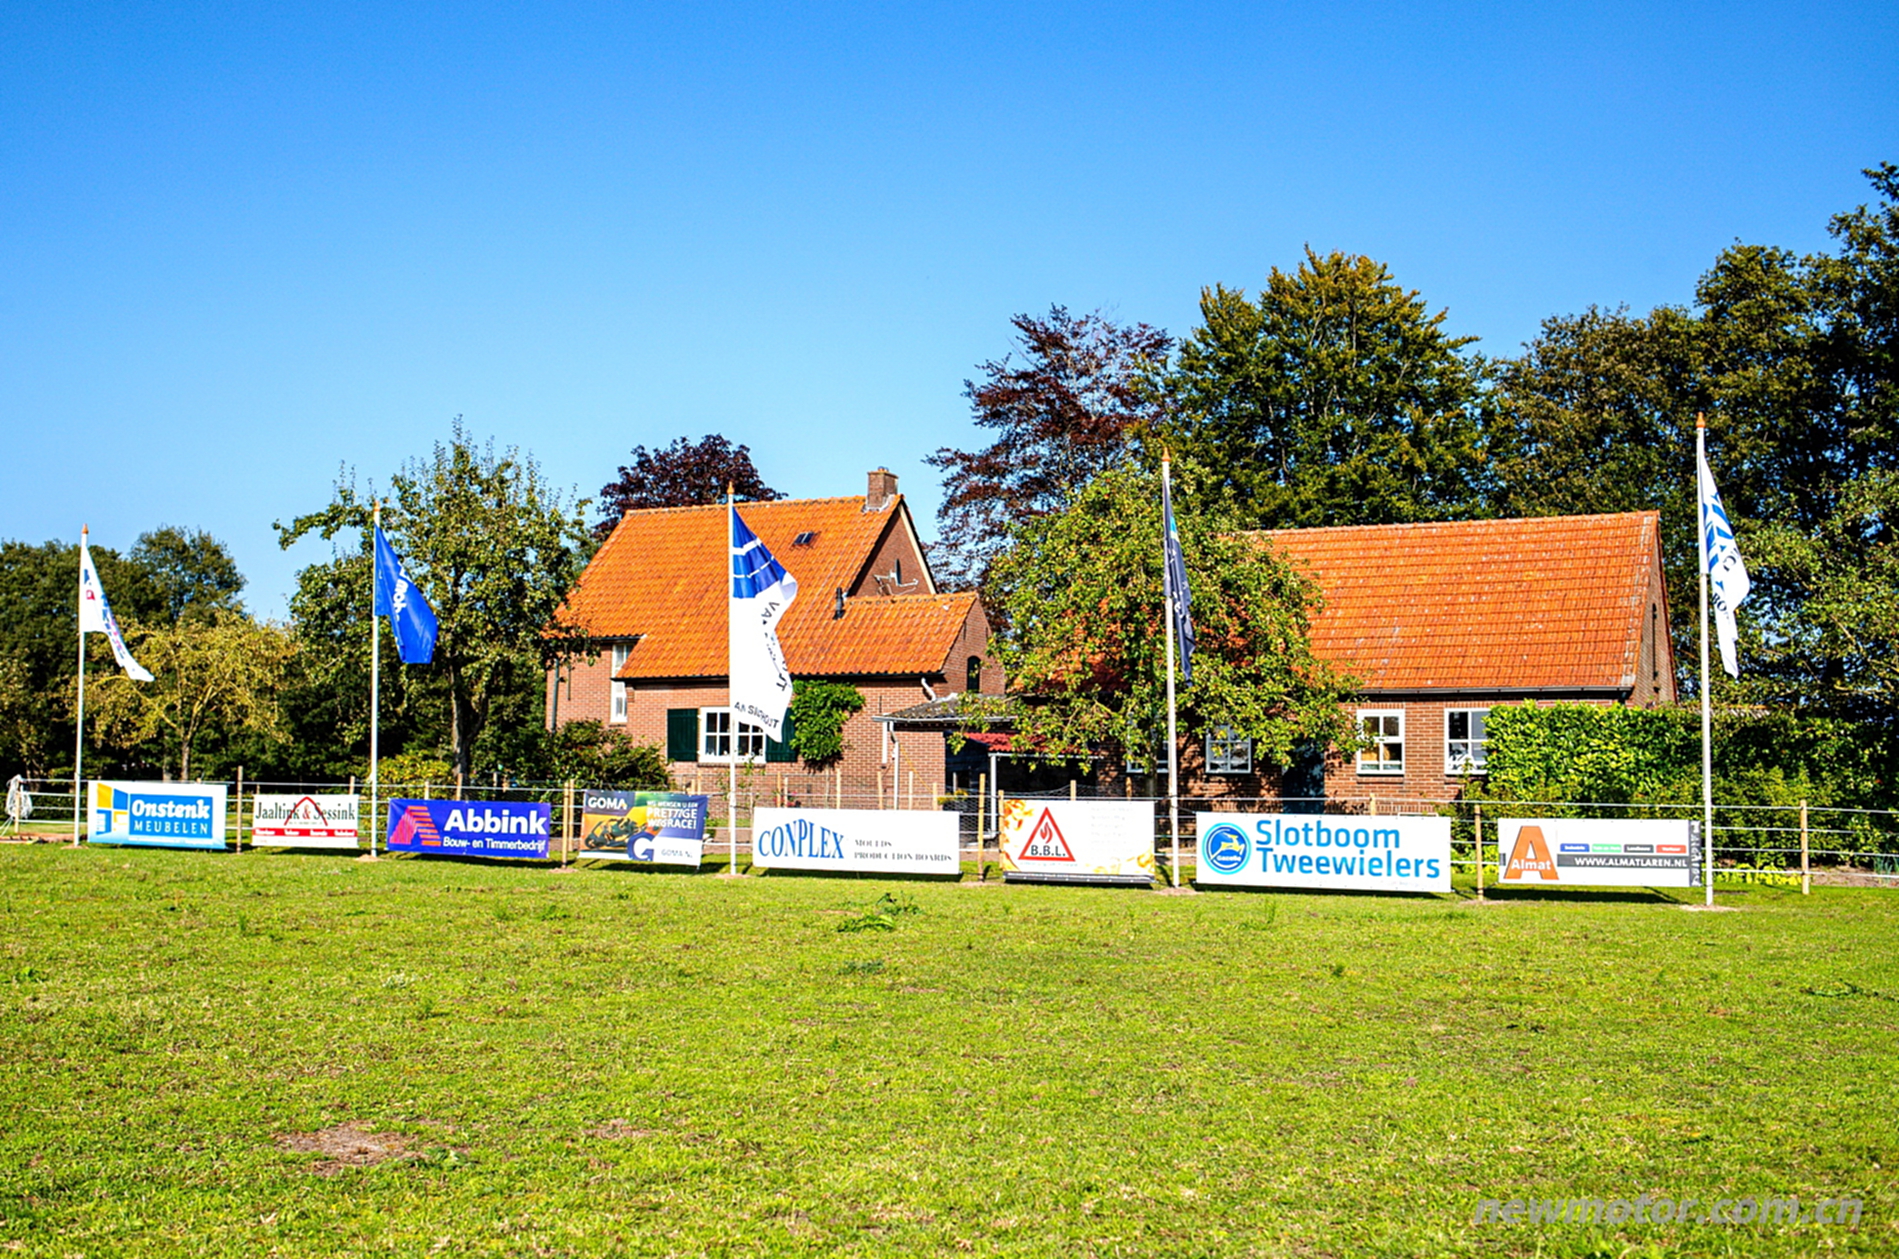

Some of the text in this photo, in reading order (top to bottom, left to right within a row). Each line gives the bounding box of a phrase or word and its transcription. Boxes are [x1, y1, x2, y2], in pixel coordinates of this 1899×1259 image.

[131, 799, 210, 819] Onstenk
[255, 802, 300, 820] Jaaltink
[302, 804, 311, 820] &
[588, 797, 628, 810] GOMA
[134, 820, 208, 834] MEUBELEN
[443, 808, 547, 835] Abbink
[758, 818, 845, 859] CONPLEX
[1255, 819, 1400, 849] Slotboom
[442, 836, 546, 853] Bouw- en Timmerbedrijf
[1030, 845, 1066, 857] B.B.L.
[1255, 847, 1440, 879] Tweewielers
[1511, 858, 1552, 871] Almat
[1574, 857, 1688, 868] WWW.ALMATLAREN.NL
